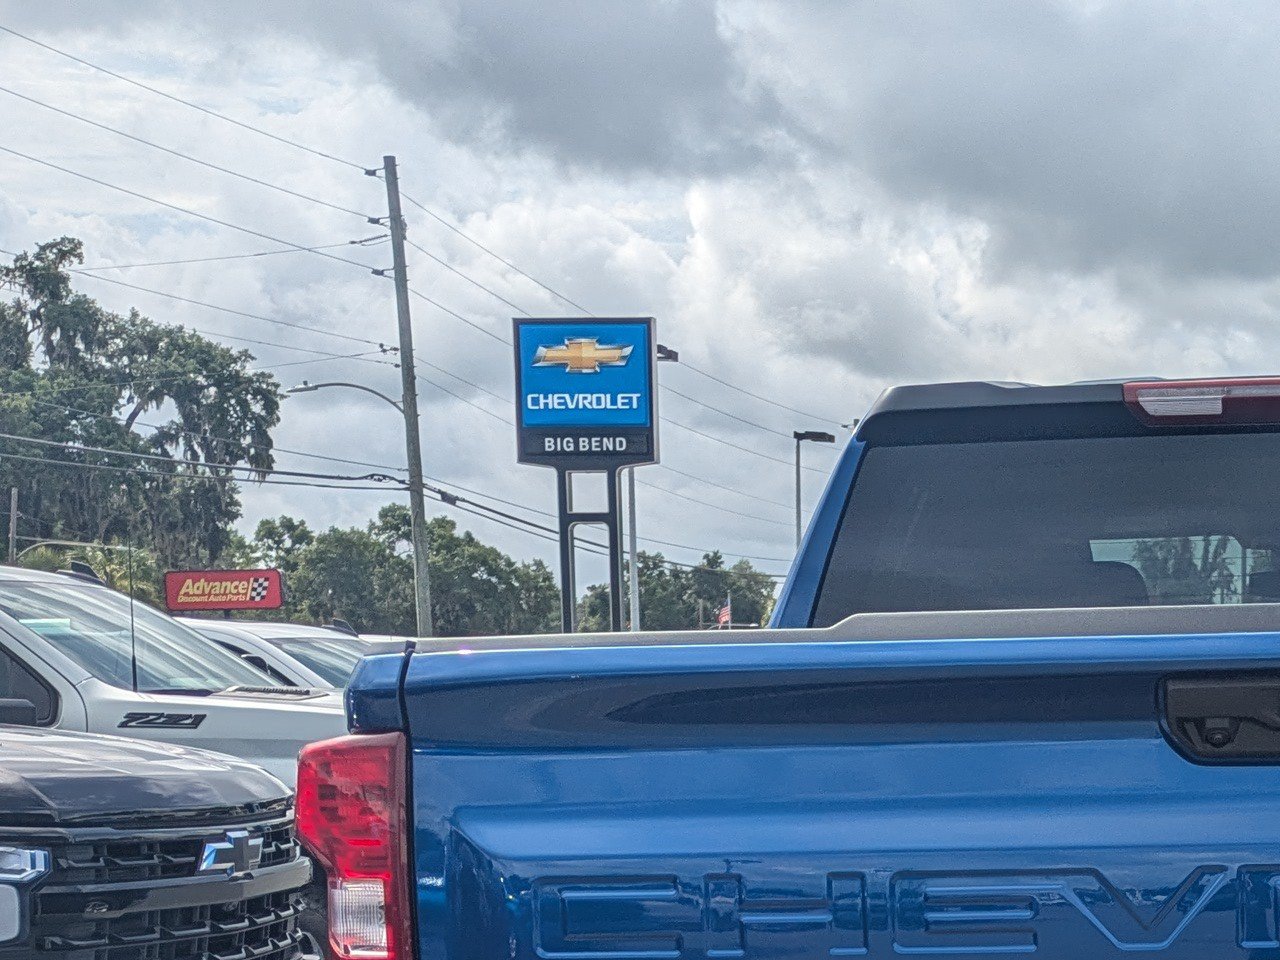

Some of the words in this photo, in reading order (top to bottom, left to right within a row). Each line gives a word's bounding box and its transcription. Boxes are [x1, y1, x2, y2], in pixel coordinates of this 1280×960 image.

[526, 393, 641, 410] CHEVROLET
[544, 437, 575, 452] BIG
[579, 437, 627, 452] BEND
[179, 578, 248, 596] Advance
[177, 594, 209, 603] Discount
[209, 593, 227, 602] Auto
[227, 593, 247, 602] Parts
